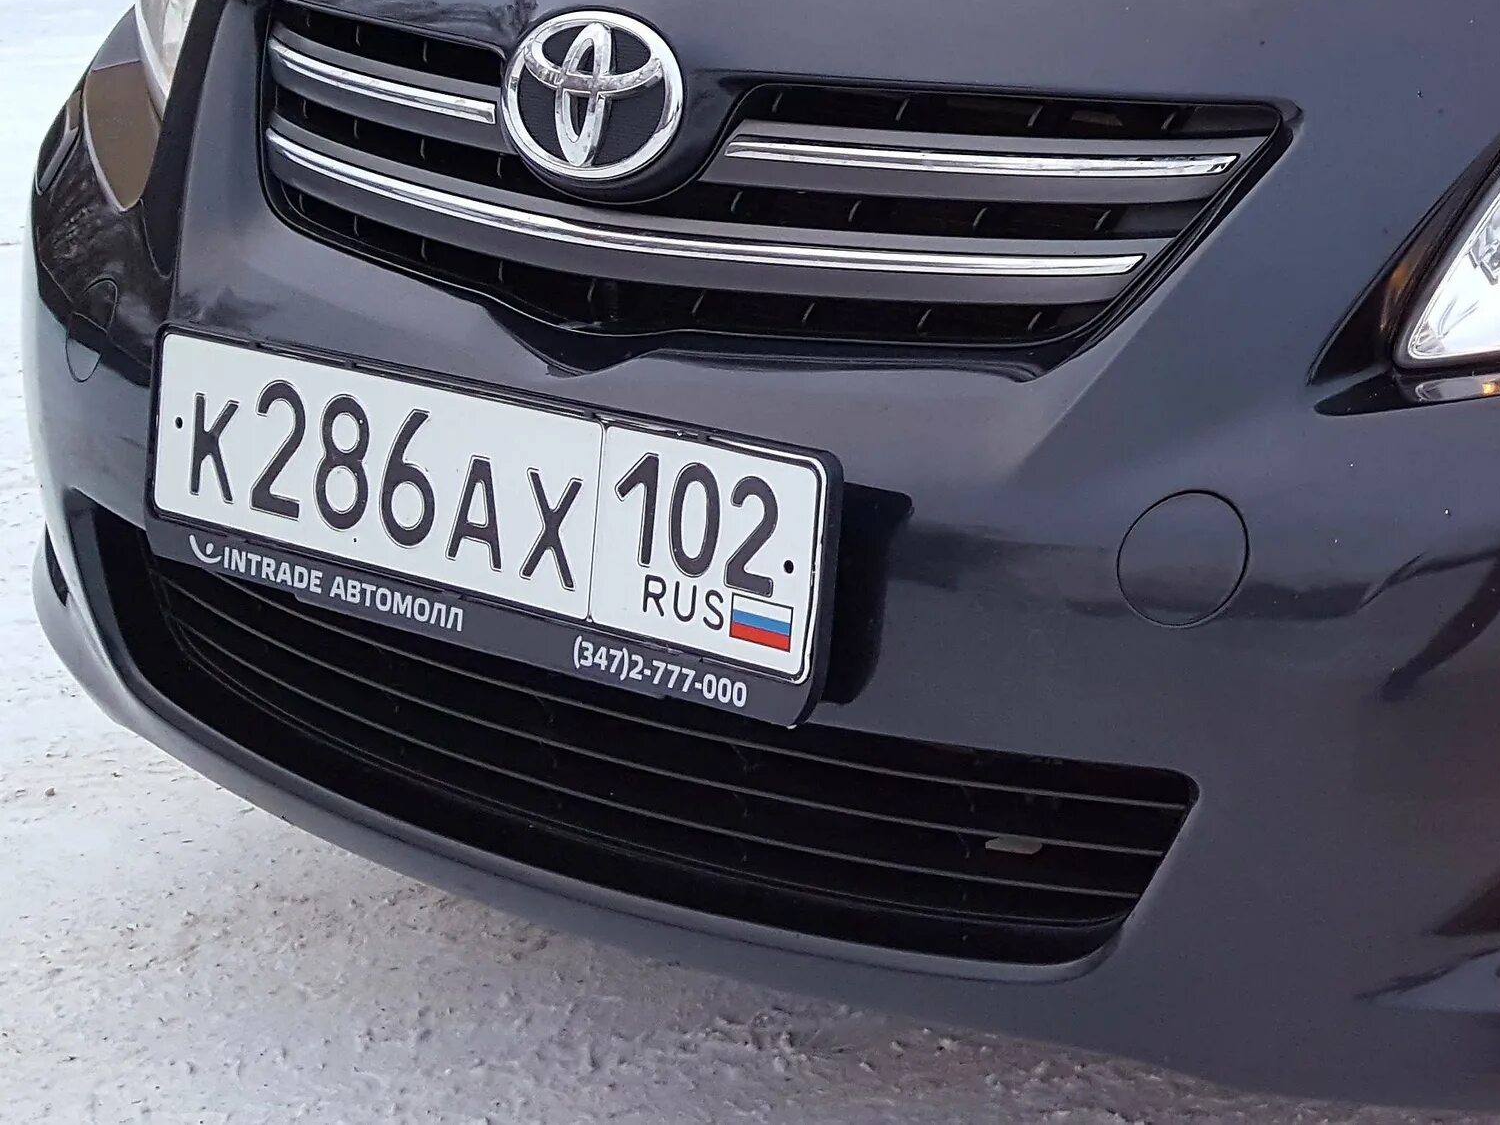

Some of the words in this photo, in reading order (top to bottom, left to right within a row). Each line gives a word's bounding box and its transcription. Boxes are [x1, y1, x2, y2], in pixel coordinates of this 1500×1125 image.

[614, 453, 780, 597] 102
[223, 546, 323, 594] INTRADE
[329, 576, 464, 632] АВТОМОЛЛ
[643, 574, 724, 631] RUS
[573, 635, 747, 708] (347)2-777-000
